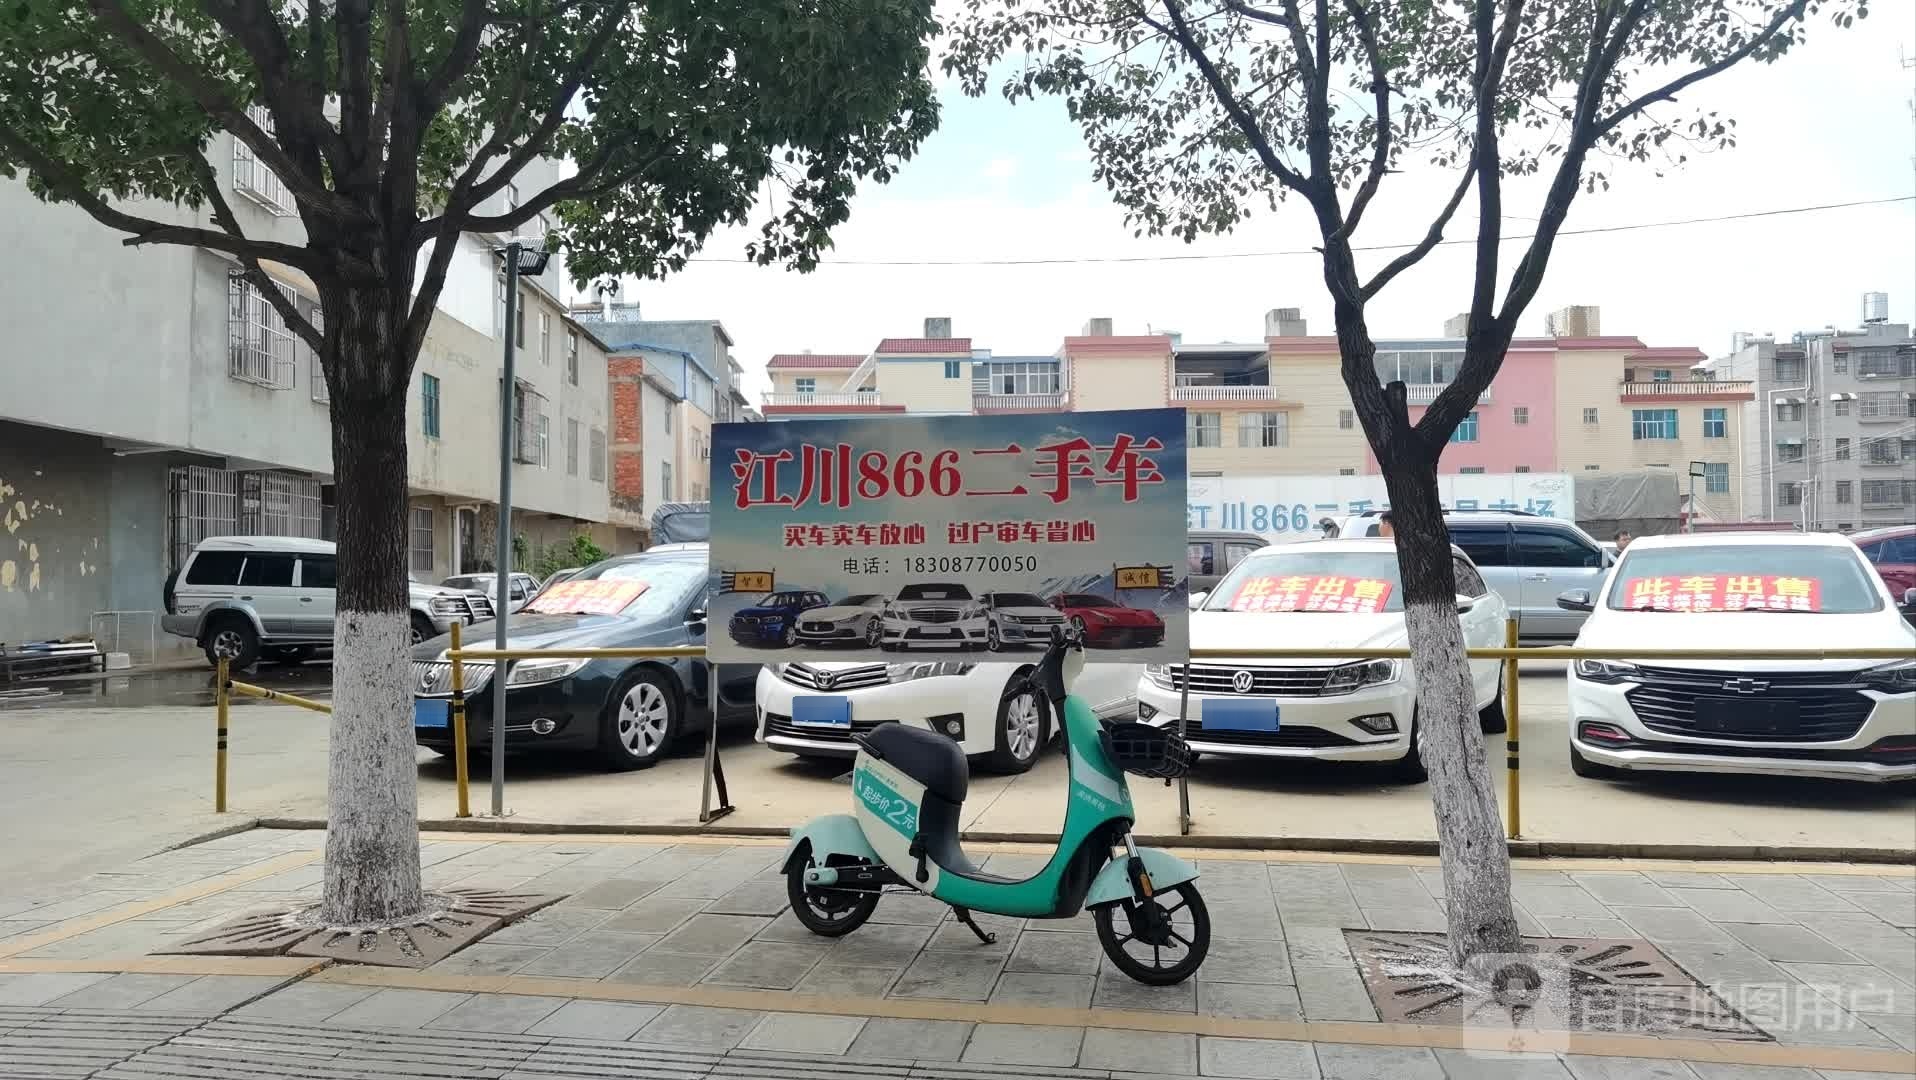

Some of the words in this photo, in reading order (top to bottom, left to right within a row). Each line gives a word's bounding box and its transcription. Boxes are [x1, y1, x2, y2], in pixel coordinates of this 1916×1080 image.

[731, 433, 1165, 510] 江川866二手车
[783, 522, 926, 547] 买车卖车放心
[947, 519, 1096, 545] 过户审车省心
[1240, 575, 1387, 600] 此车出售
[1633, 575, 1812, 597] 此车出售
[862, 785, 916, 830] 起步价2元
